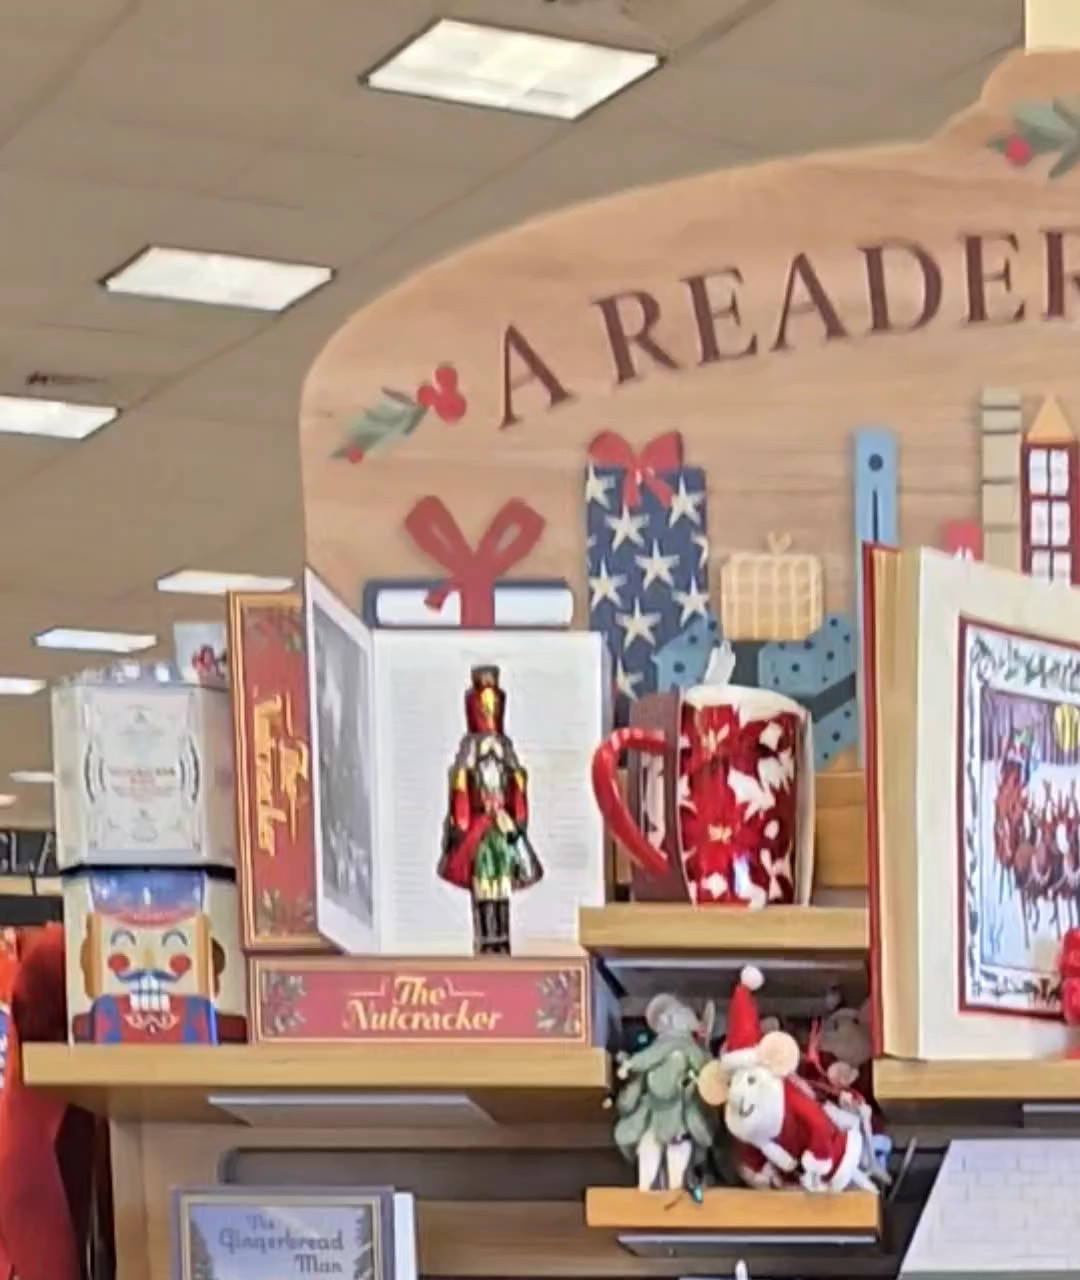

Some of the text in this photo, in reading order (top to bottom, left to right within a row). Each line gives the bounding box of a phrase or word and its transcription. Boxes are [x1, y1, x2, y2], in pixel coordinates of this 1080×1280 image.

[499, 324, 578, 431] A
[394, 974, 447, 1005] The
[343, 999, 502, 1032] Nutcracker
[218, 1228, 344, 1254] Gingerbread
[293, 1254, 343, 1273] Man
